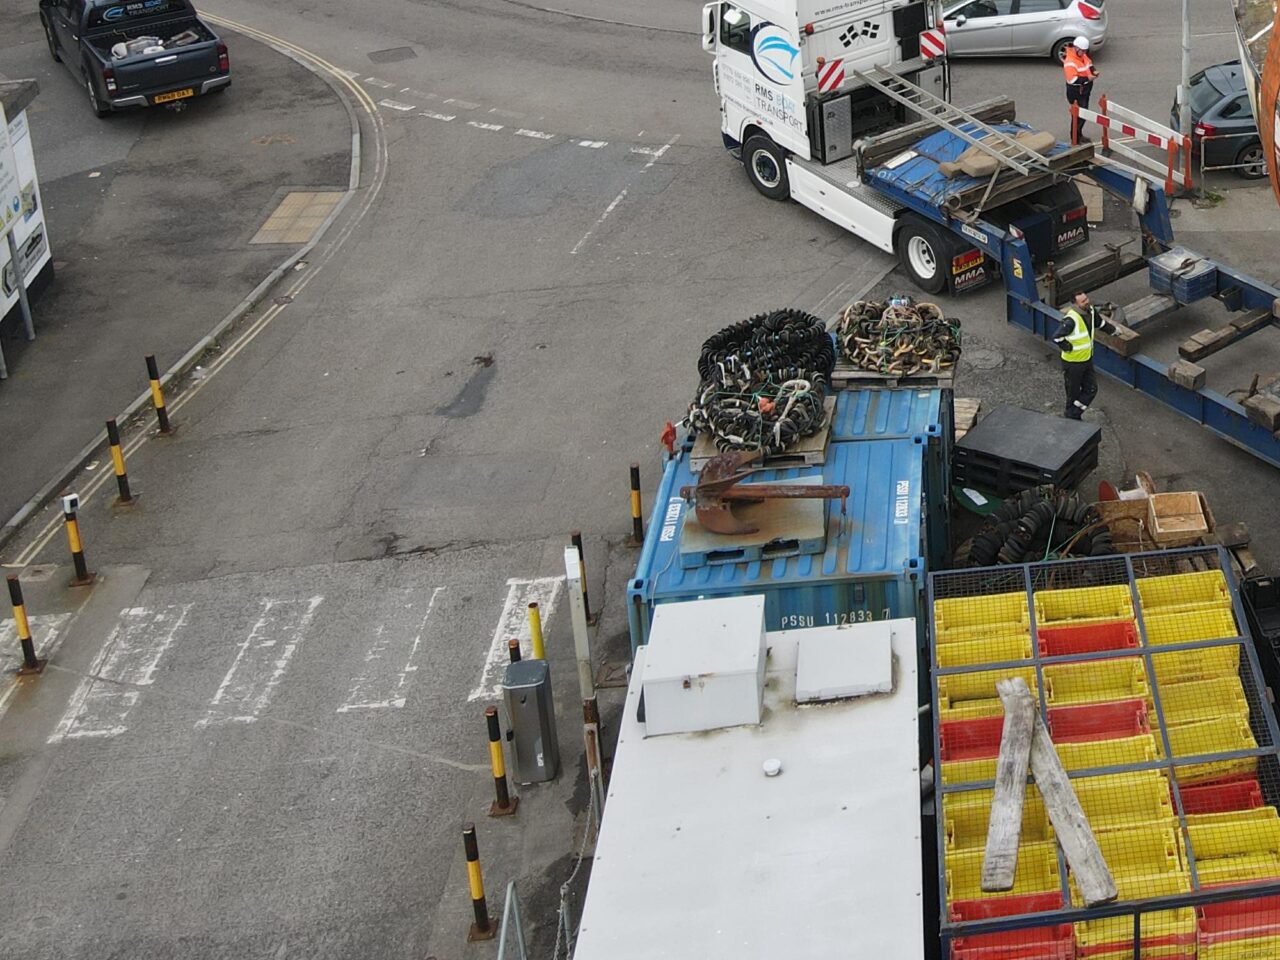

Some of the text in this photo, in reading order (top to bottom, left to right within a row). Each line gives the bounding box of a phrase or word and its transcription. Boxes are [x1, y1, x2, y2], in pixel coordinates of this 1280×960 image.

[126, 0, 162, 11] RMS BOAT
[754, 83, 774, 102] RMS
[756, 96, 803, 131] TRANSPORT
[1057, 225, 1085, 244] MMA
[954, 266, 985, 285] MMA
[781, 614, 814, 629] PSSU
[825, 610, 873, 625] 112833
